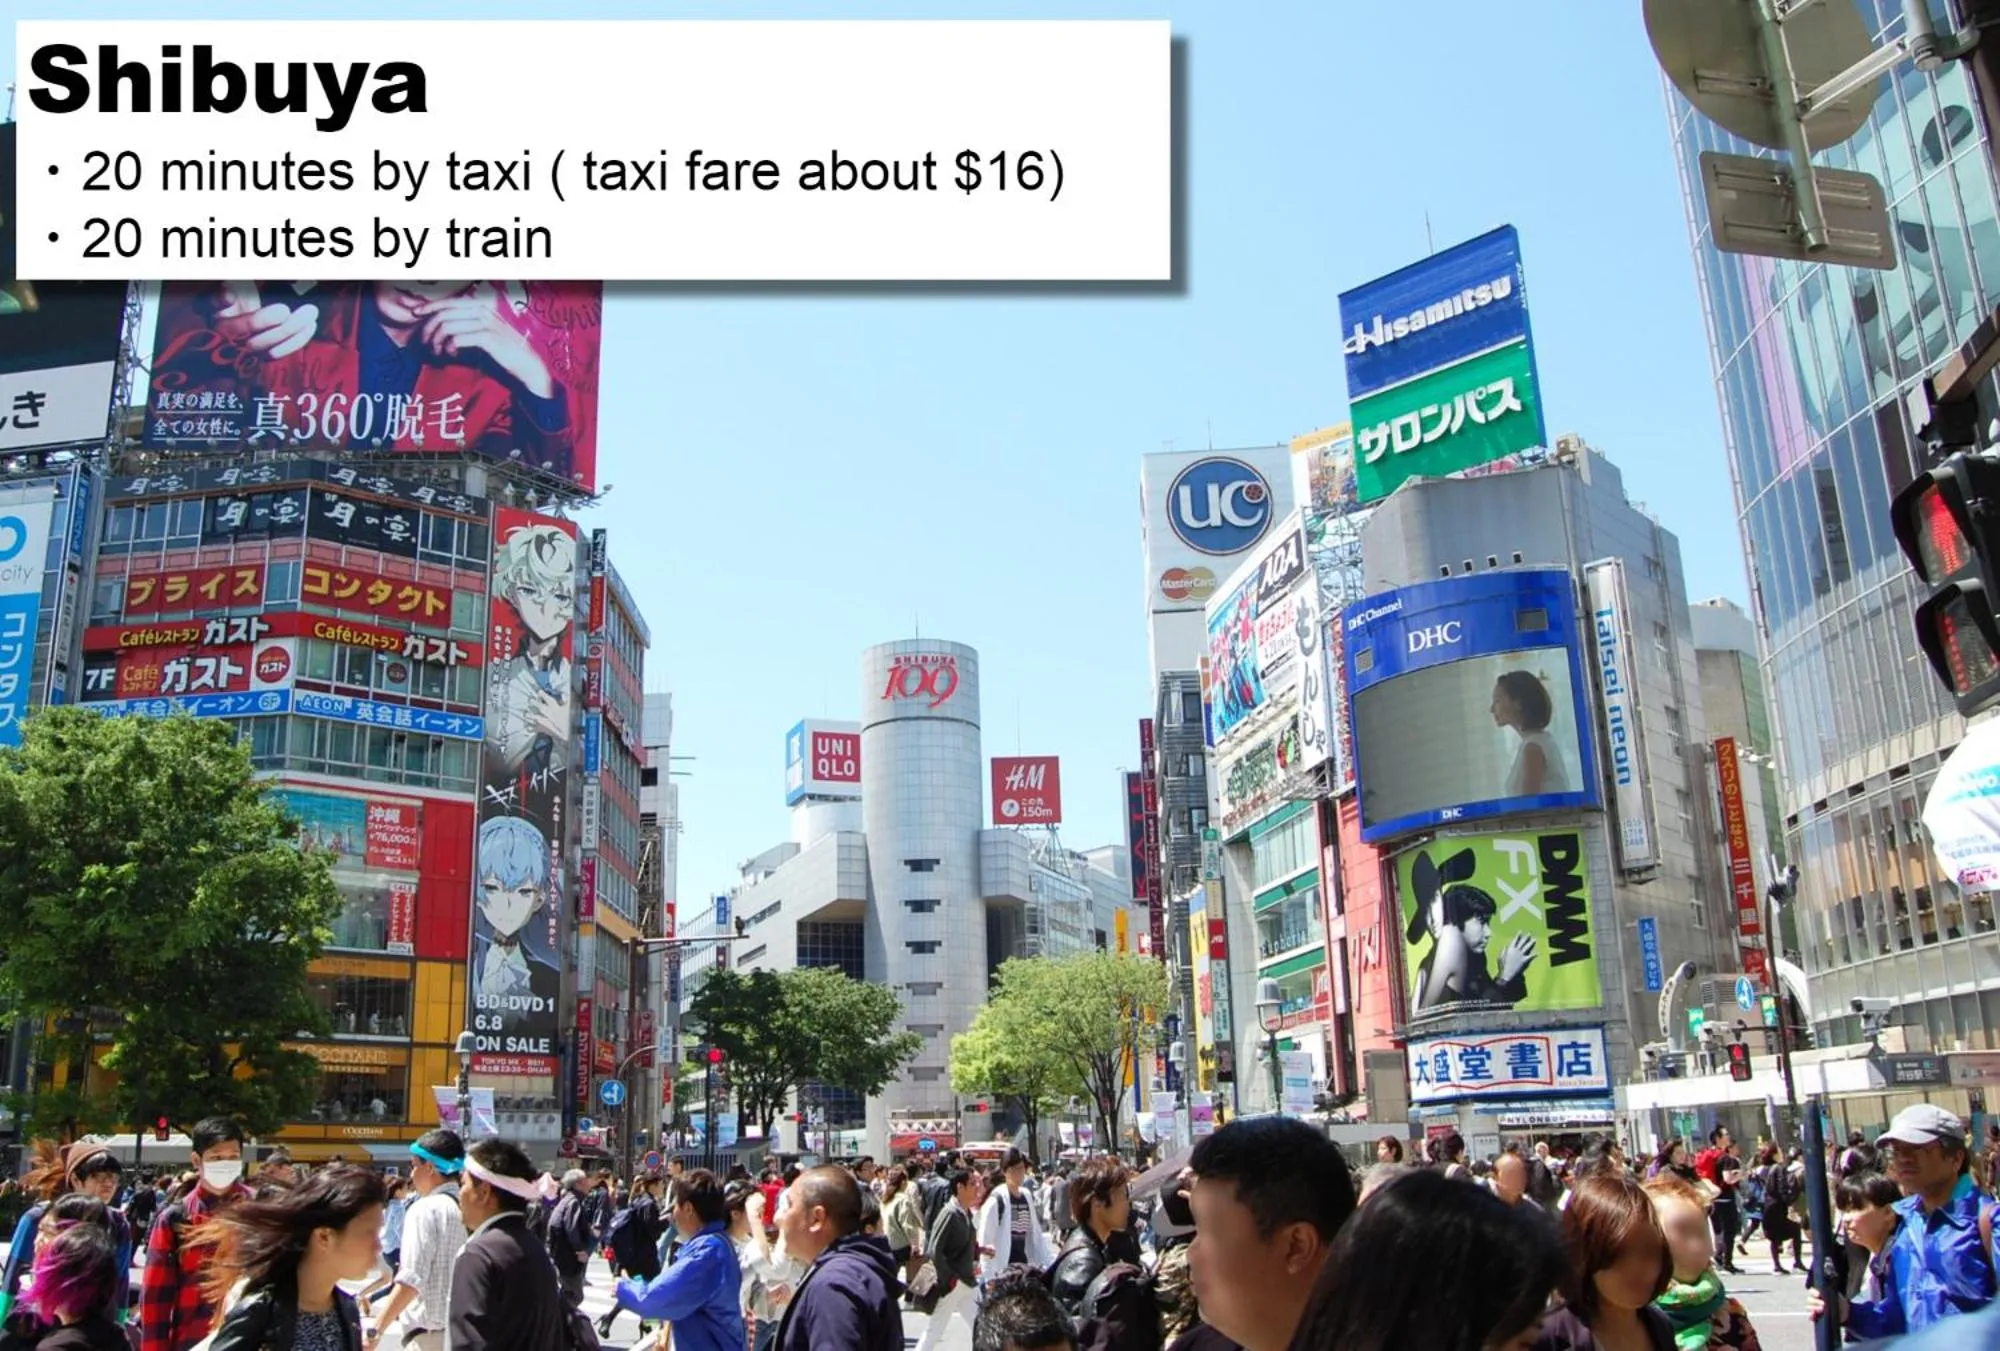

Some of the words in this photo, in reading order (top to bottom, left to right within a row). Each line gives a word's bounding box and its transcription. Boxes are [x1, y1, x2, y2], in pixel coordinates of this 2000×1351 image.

[1343, 275, 1512, 355] Hisamitsu
[0, 391, 46, 429] き
[156, 391, 243, 411] 真実の満足を、
[152, 418, 241, 437] 全ての女性に。
[1358, 377, 1522, 464] サロンパス
[129, 569, 259, 606] プライス
[304, 566, 446, 617] コンタクト
[1365, 598, 1403, 621] Channel
[204, 617, 269, 645] ガスト
[1408, 621, 1462, 653] DHC
[403, 634, 468, 666] ガスト
[894, 656, 956, 665] SHIBUYA
[1594, 602, 1625, 700] Taisei
[86, 668, 116, 690] 7F
[123, 664, 158, 681] Café
[161, 655, 243, 694] ガスト
[260, 662, 287, 674] ガスト
[881, 664, 959, 709] 109
[302, 695, 345, 711] AEON
[357, 702, 480, 735] 英会話イーオン
[817, 738, 851, 756] UNI
[1608, 705, 1631, 786] neon
[817, 758, 856, 778] QLO
[1004, 764, 1046, 791] H&M
[1021, 807, 1053, 818] 150m
[1441, 807, 1462, 819] DHC
[1492, 838, 1542, 924] FX
[1537, 833, 1592, 968] DMM
[476, 993, 544, 1012] BD&DVD
[546, 998, 555, 1013] 1
[475, 1014, 503, 1030] 6.8
[475, 1035, 501, 1051] ON
[506, 1036, 550, 1053] SALE
[1415, 1041, 1593, 1087] 大盛堂書店
